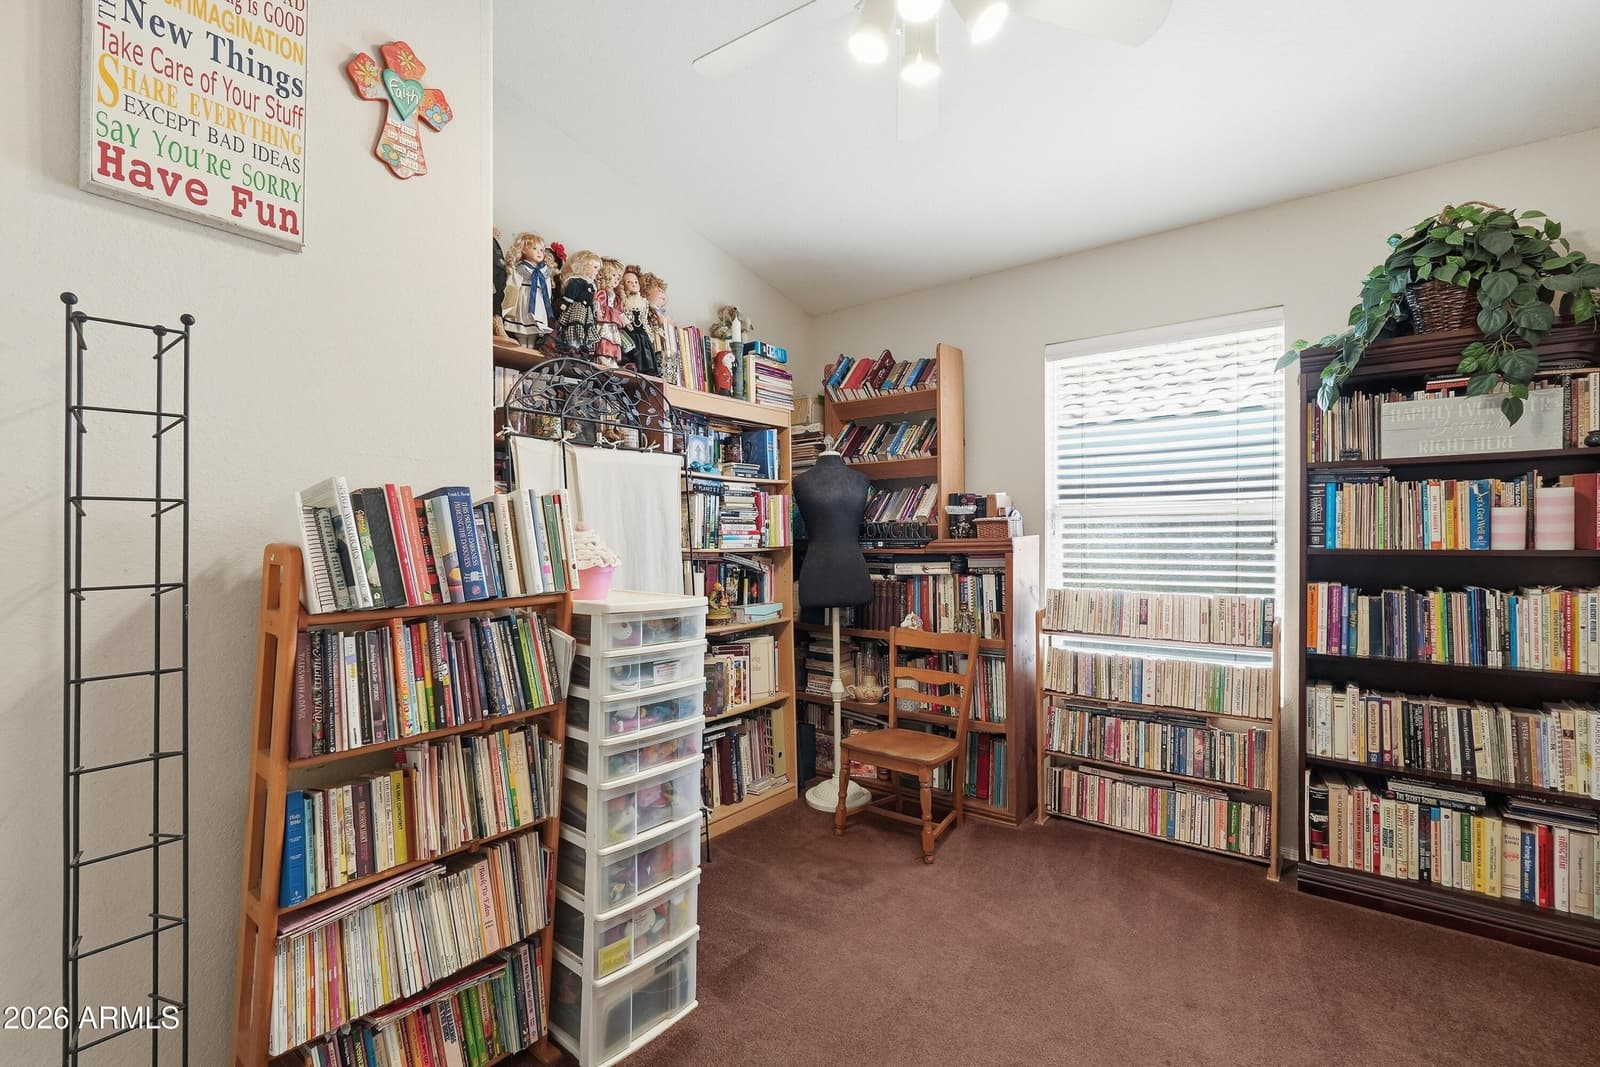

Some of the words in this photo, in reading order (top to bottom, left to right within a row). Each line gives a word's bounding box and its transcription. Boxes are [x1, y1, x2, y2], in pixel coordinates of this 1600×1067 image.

[186, 0, 305, 65] IMAGINATION
[263, 1, 305, 37] GOOD
[121, 0, 194, 49] New
[205, 31, 303, 99] Things
[97, 20, 144, 66] Take
[150, 46, 194, 87] Care
[200, 70, 218, 96] of
[222, 75, 260, 113] Your
[265, 94, 304, 130] Stuff
[390, 79, 419, 105] Faith
[97, 52, 178, 110] SHARE
[189, 92, 302, 156] EVERYTHING
[123, 93, 200, 138] EXCEPT
[207, 126, 246, 154] BAD
[252, 143, 301, 175] IDEAS
[97, 140, 209, 206] Have
[231, 184, 300, 236] Fun
[1391, 403, 1450, 422] HAPPILY
[1418, 437, 1465, 455] RIGHT
[464, 513, 473, 536] PRESENT
[861, 522, 933, 539] OWGIRL
[1476, 508, 1486, 520] Get
[1477, 520, 1487, 535] Well
[343, 511, 360, 559] WARRIORS
[453, 500, 464, 526] PIERCING
[460, 539, 471, 567] DARKNESS
[468, 536, 479, 566] DARKNESS
[313, 648, 321, 690] MIGHTY
[313, 695, 322, 722] WIND
